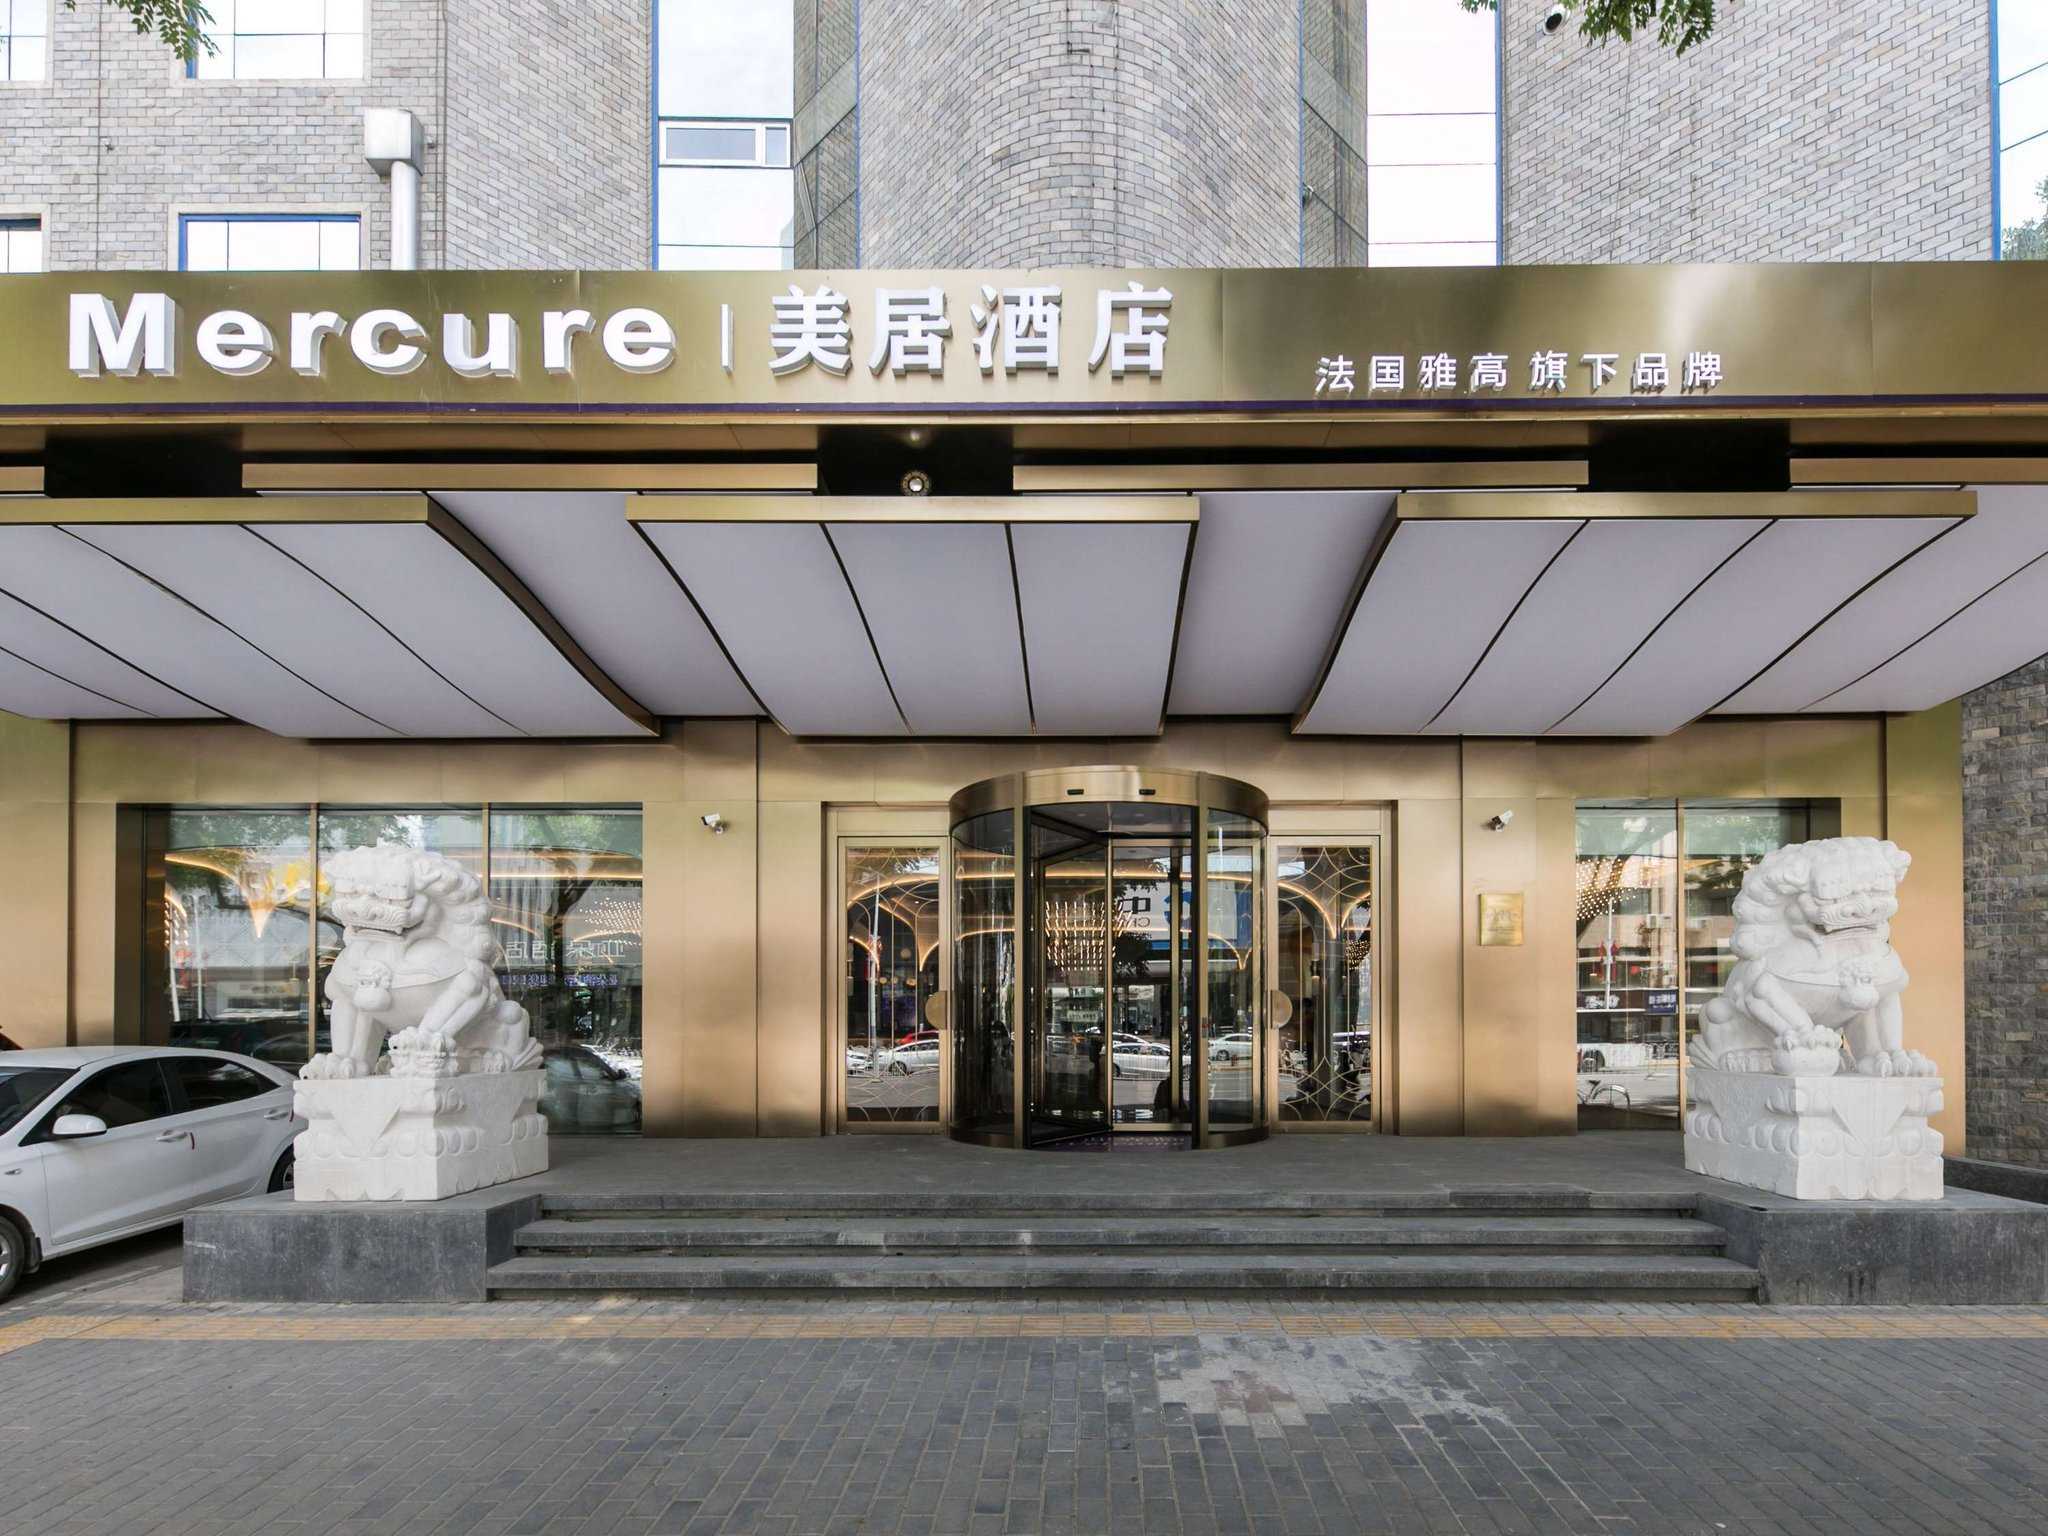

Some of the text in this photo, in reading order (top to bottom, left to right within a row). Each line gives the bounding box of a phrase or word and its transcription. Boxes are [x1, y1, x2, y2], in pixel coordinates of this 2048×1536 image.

[68, 293, 676, 376] Mercure
[768, 281, 1175, 377] 美居酒店
[1315, 350, 1724, 394] 法国雅高旗下品牌
